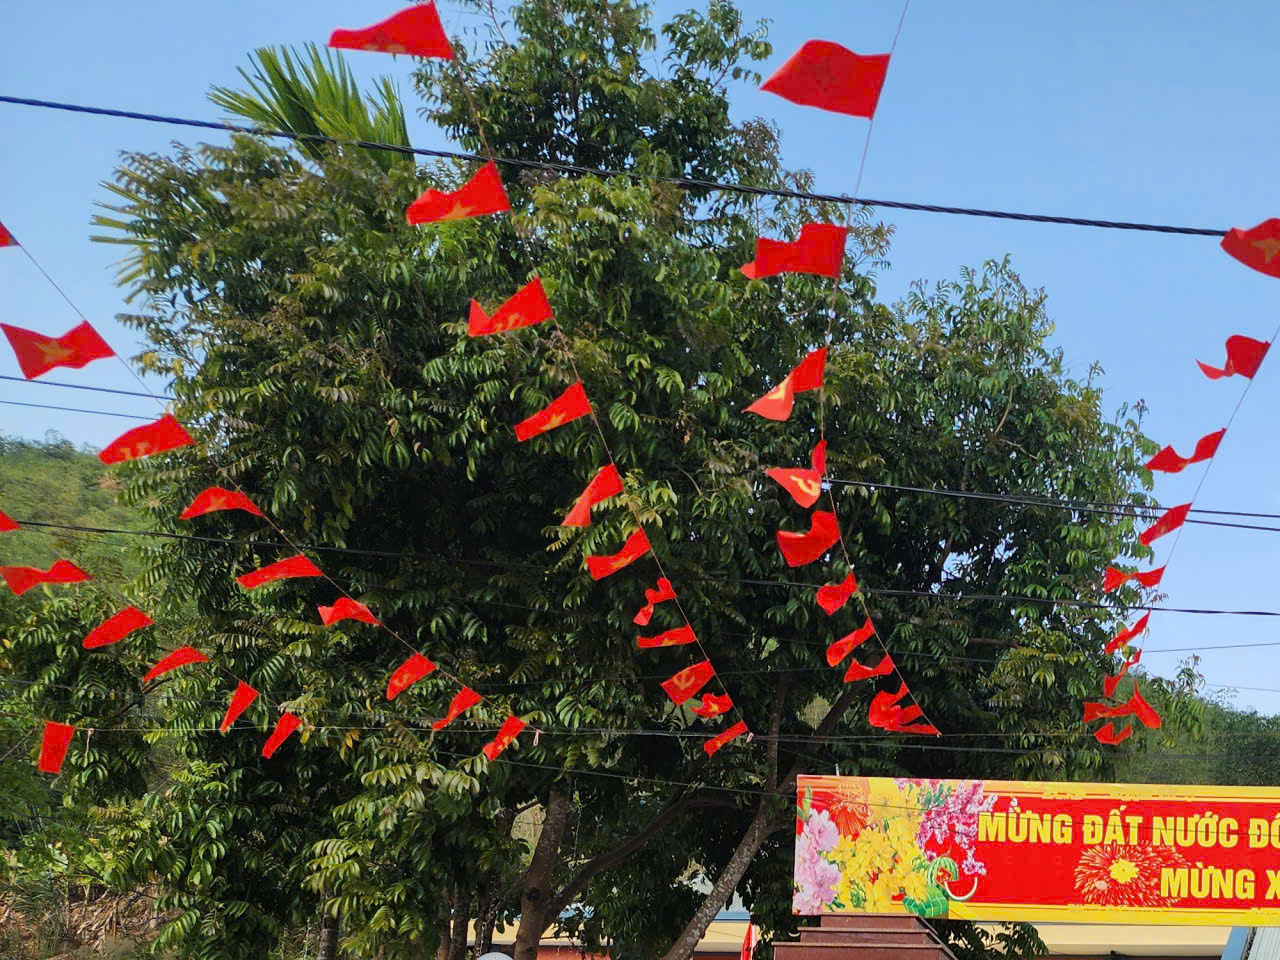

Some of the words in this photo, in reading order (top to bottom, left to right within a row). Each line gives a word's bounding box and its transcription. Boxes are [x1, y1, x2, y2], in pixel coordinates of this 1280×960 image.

[978, 806, 1073, 845] MỪNG
[1082, 805, 1143, 846] ĐẤT
[1152, 811, 1239, 848] NƯỚC
[1160, 861, 1255, 899] MỪNG
